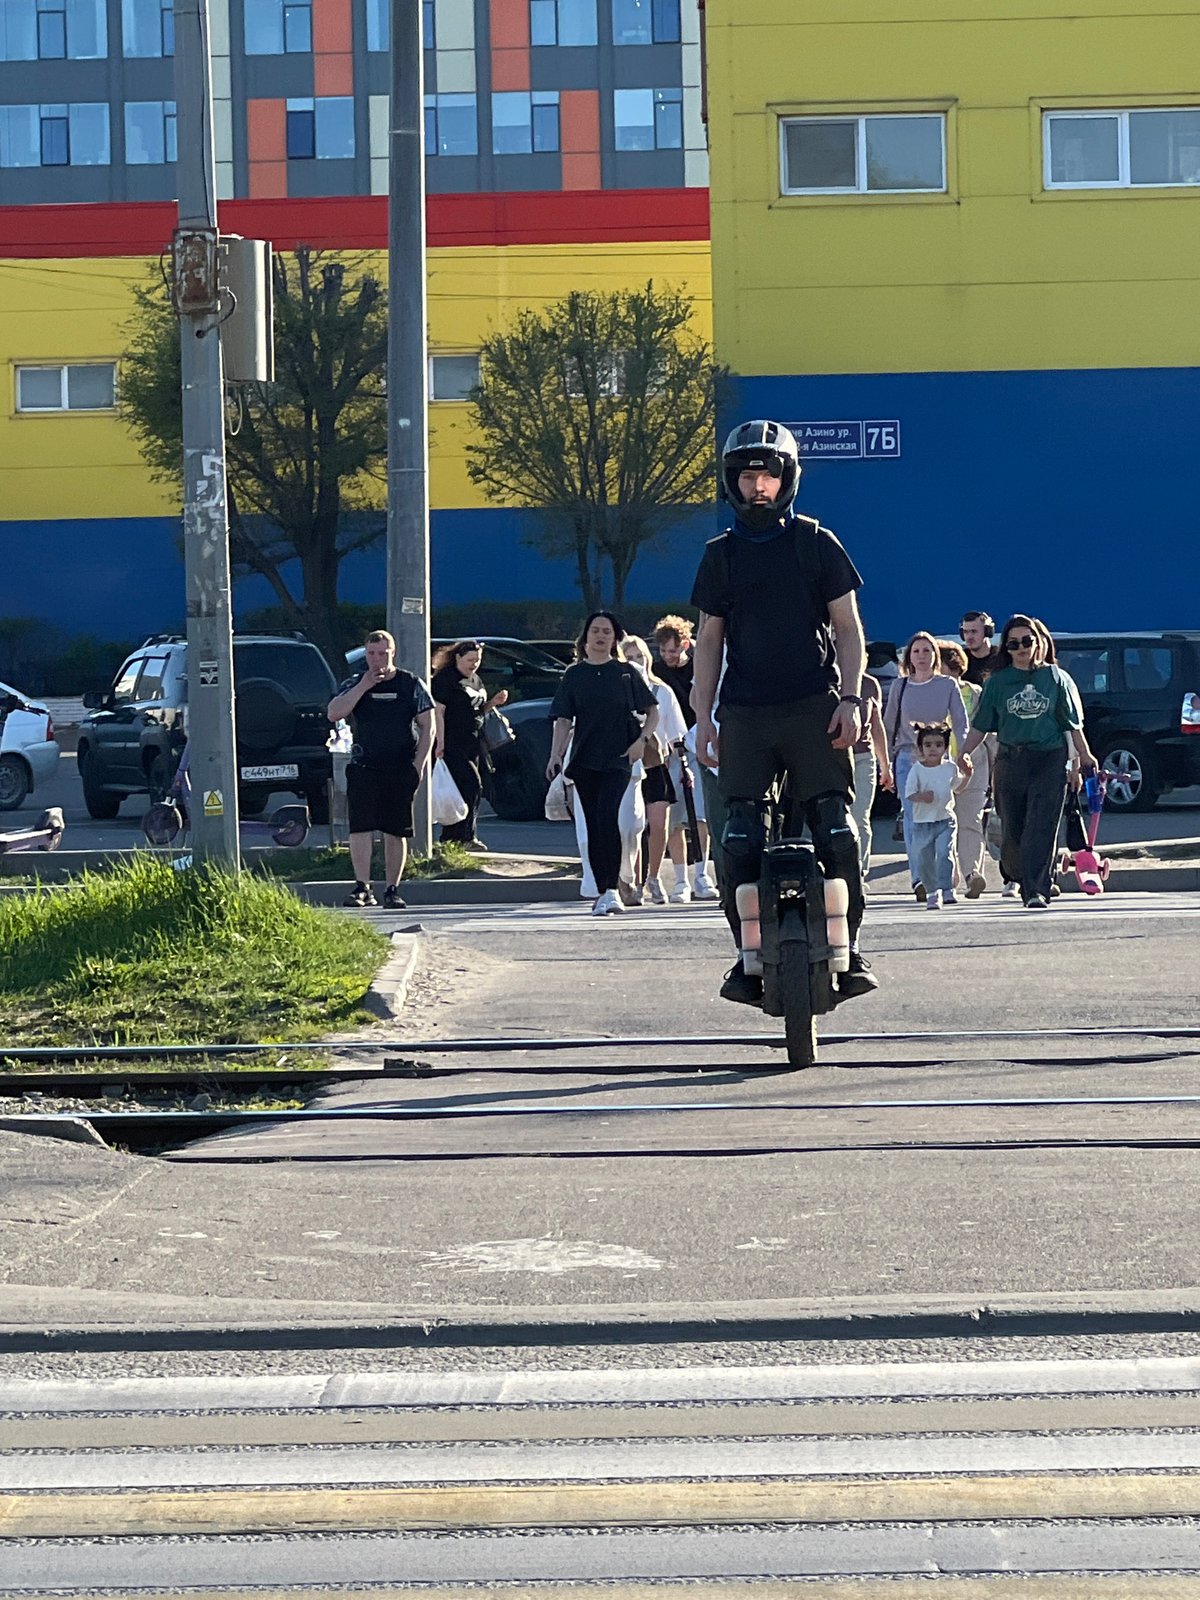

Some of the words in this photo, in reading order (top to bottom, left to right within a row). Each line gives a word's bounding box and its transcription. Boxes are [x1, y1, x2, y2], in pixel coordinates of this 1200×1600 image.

[805, 427, 835, 437] Азино
[838, 428, 852, 439] ур.
[867, 427, 896, 450] 7Б
[811, 441, 857, 451] Азинская
